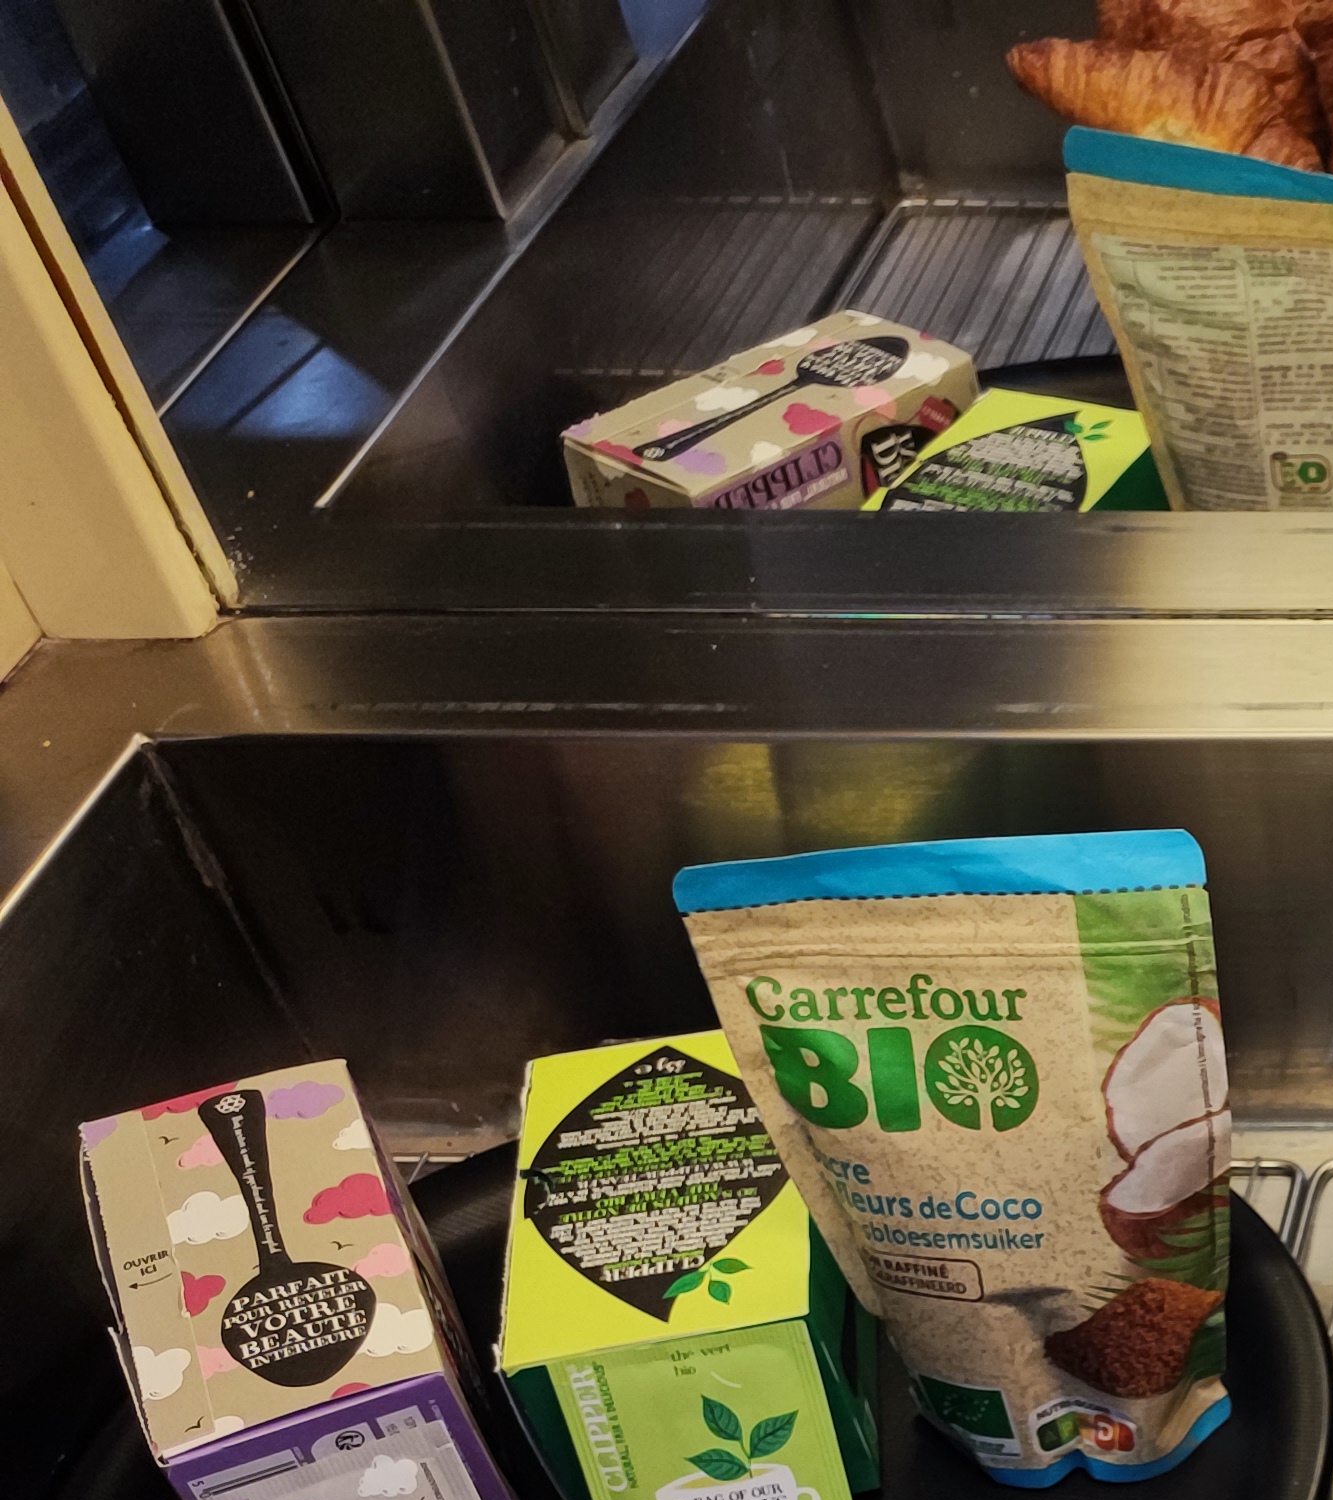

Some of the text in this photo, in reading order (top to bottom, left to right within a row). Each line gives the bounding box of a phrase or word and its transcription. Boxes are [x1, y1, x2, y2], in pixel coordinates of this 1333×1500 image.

[745, 974, 1027, 1023] Carrefour
[761, 1024, 1040, 1132] BIO
[920, 1192, 1042, 1220] de Coco
[232, 1269, 352, 1312] PARFAIT
[224, 1305, 275, 1329] POUR
[239, 1294, 357, 1338] VOTRE
[570, 1363, 628, 1493] CLIPPER
[751, 1482, 783, 1498] OUR
